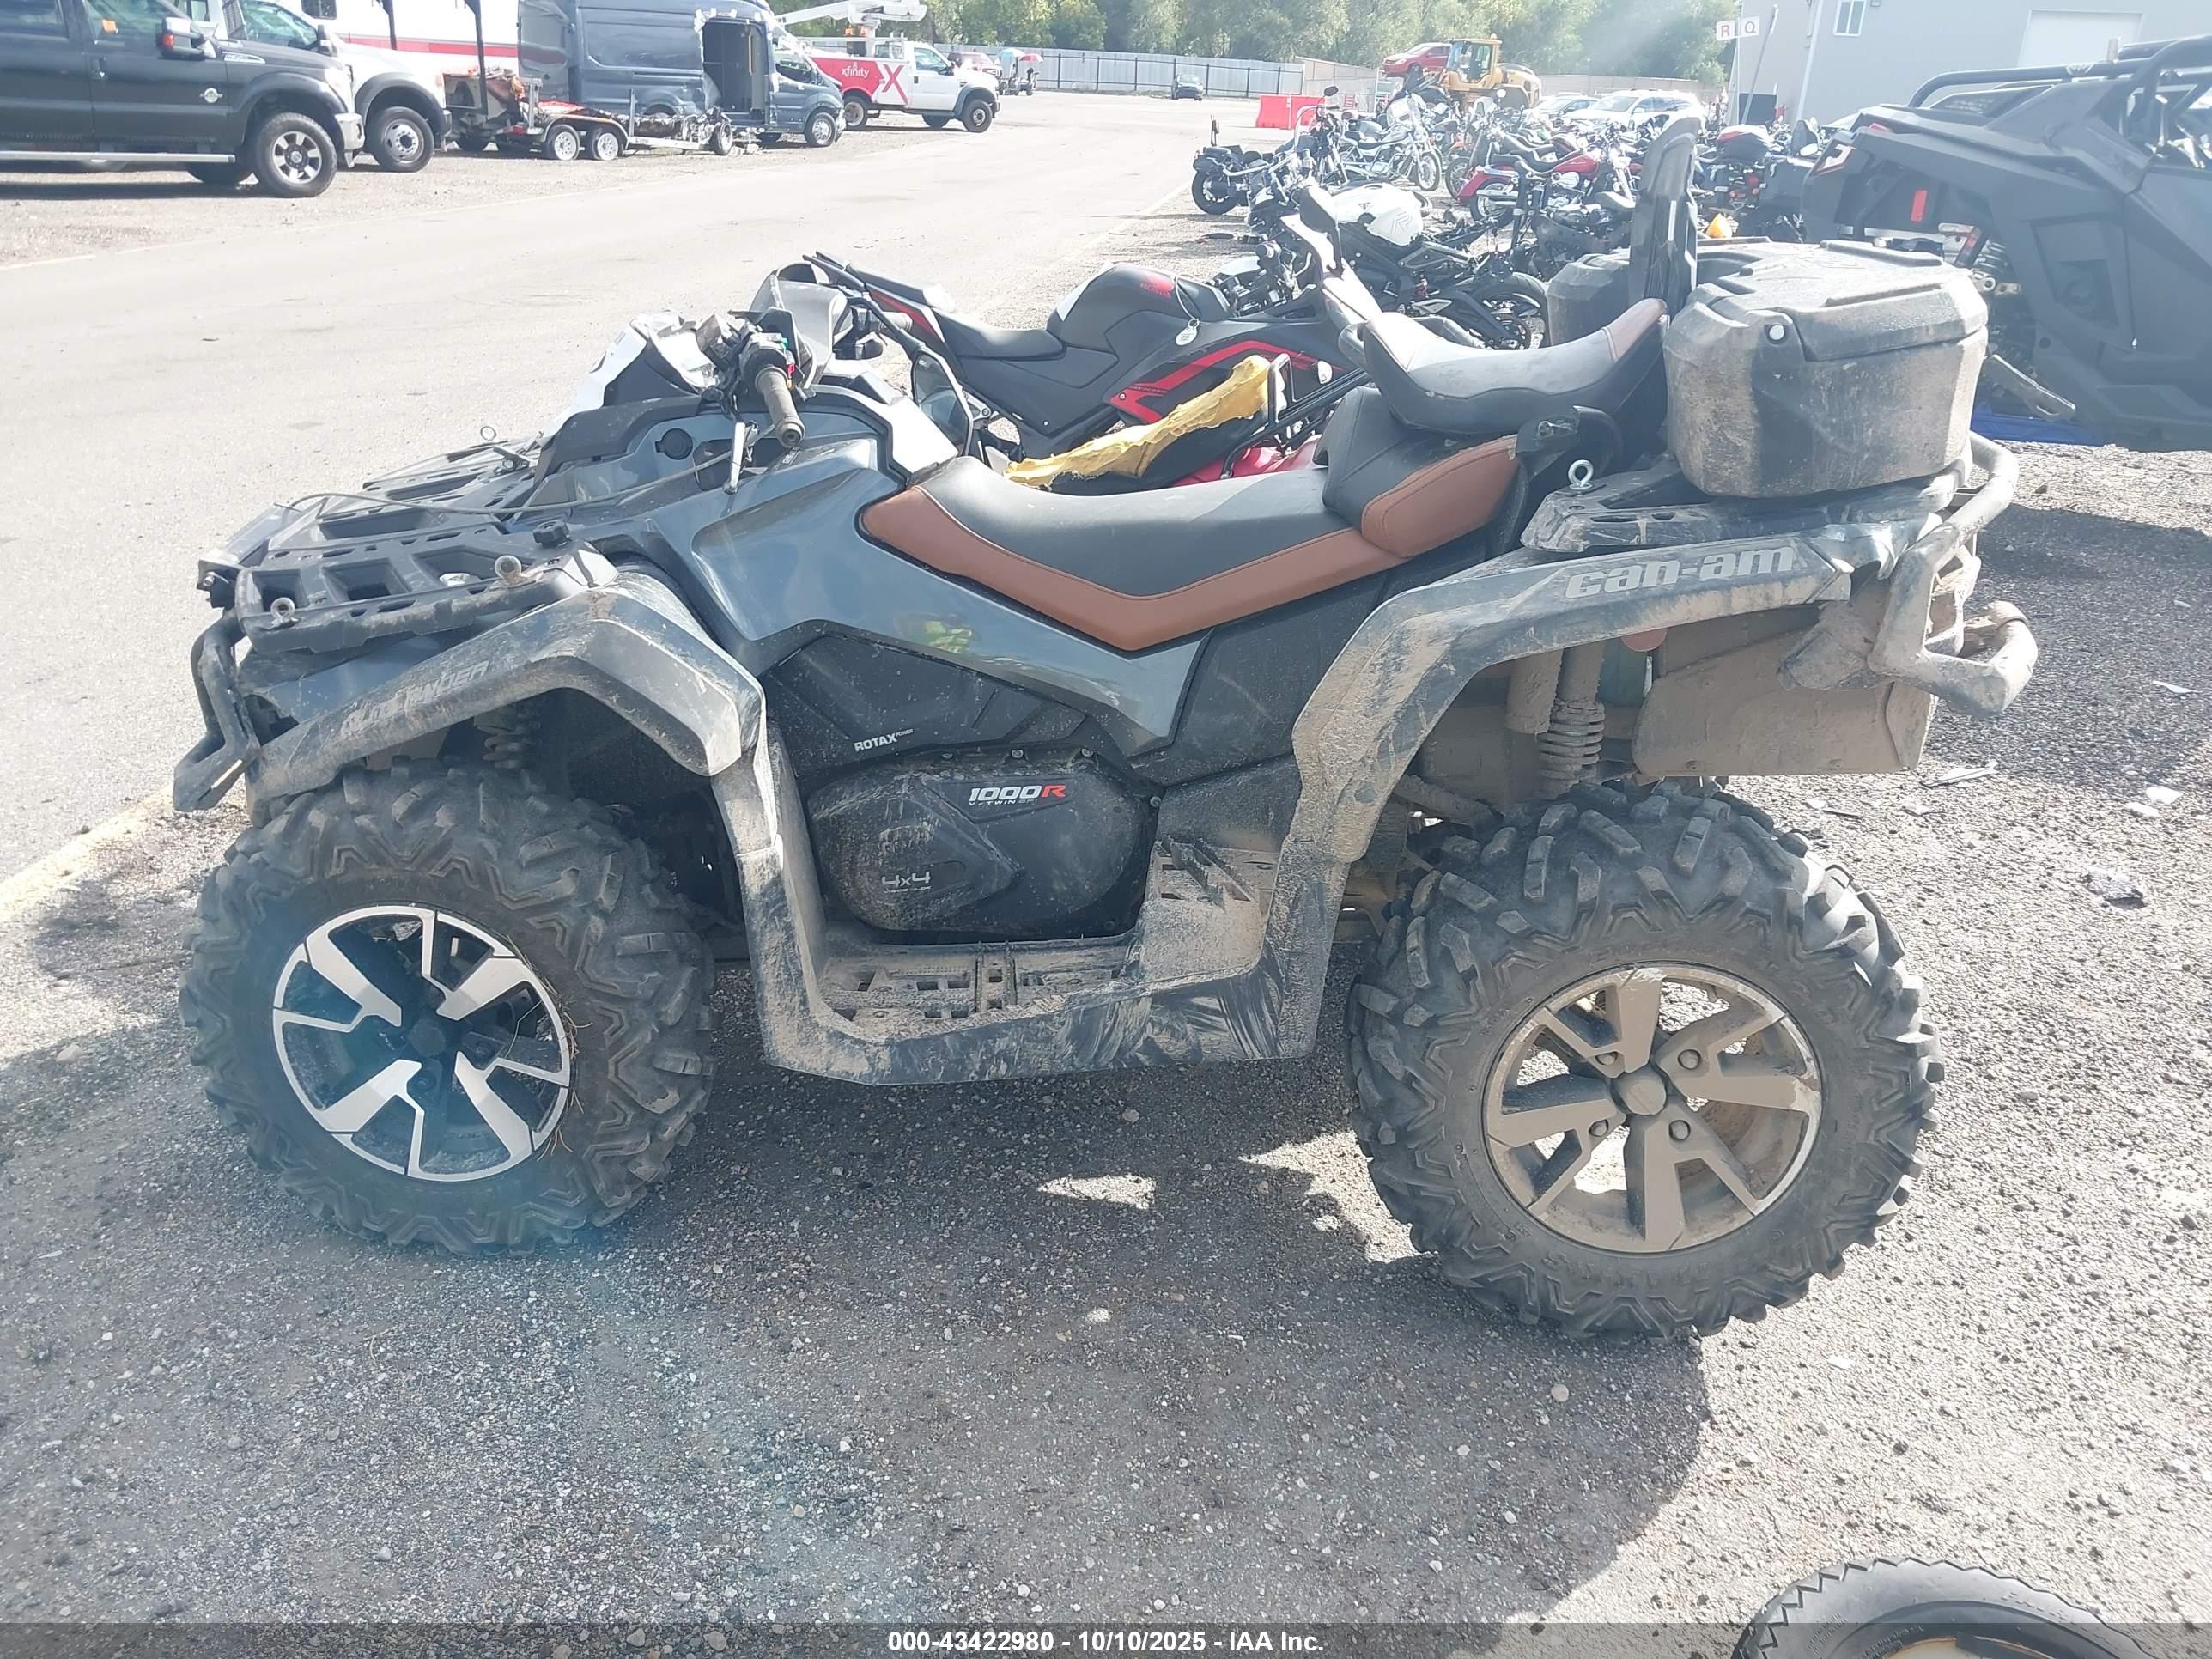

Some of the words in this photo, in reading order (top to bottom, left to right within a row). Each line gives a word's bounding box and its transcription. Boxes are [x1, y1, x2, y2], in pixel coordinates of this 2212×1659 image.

[1721, 25, 1731, 38] R
[1745, 21, 1757, 33] Q
[842, 63, 869, 78] xfinity
[854, 732, 898, 752] ROTAX
[969, 784, 1066, 801] 1000R
[882, 871, 931, 889] 4x4
